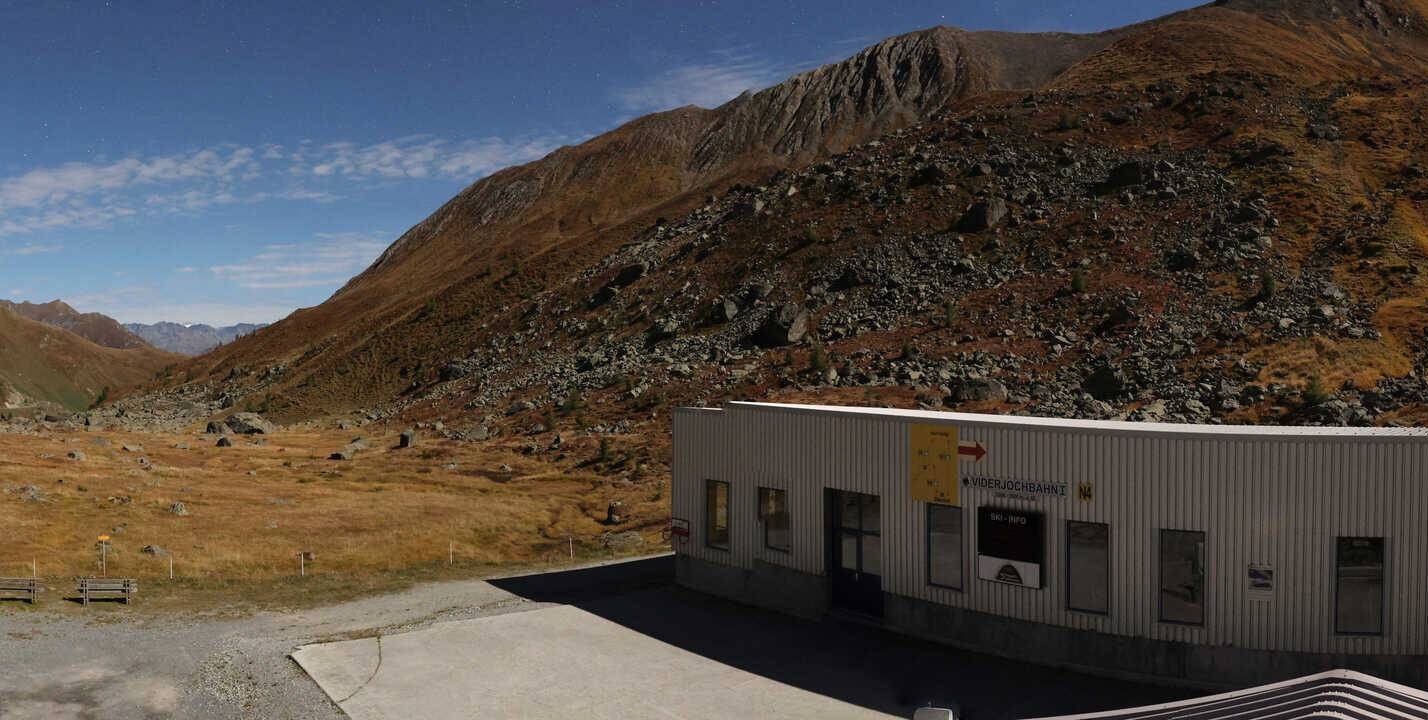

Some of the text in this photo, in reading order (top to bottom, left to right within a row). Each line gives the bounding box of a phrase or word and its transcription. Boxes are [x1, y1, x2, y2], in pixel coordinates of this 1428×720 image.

[971, 478, 1058, 495] VIDERJOCHBAHN
[1079, 483, 1092, 500] N4
[990, 512, 1003, 521] SKI
[1008, 515, 1027, 525] INFO
